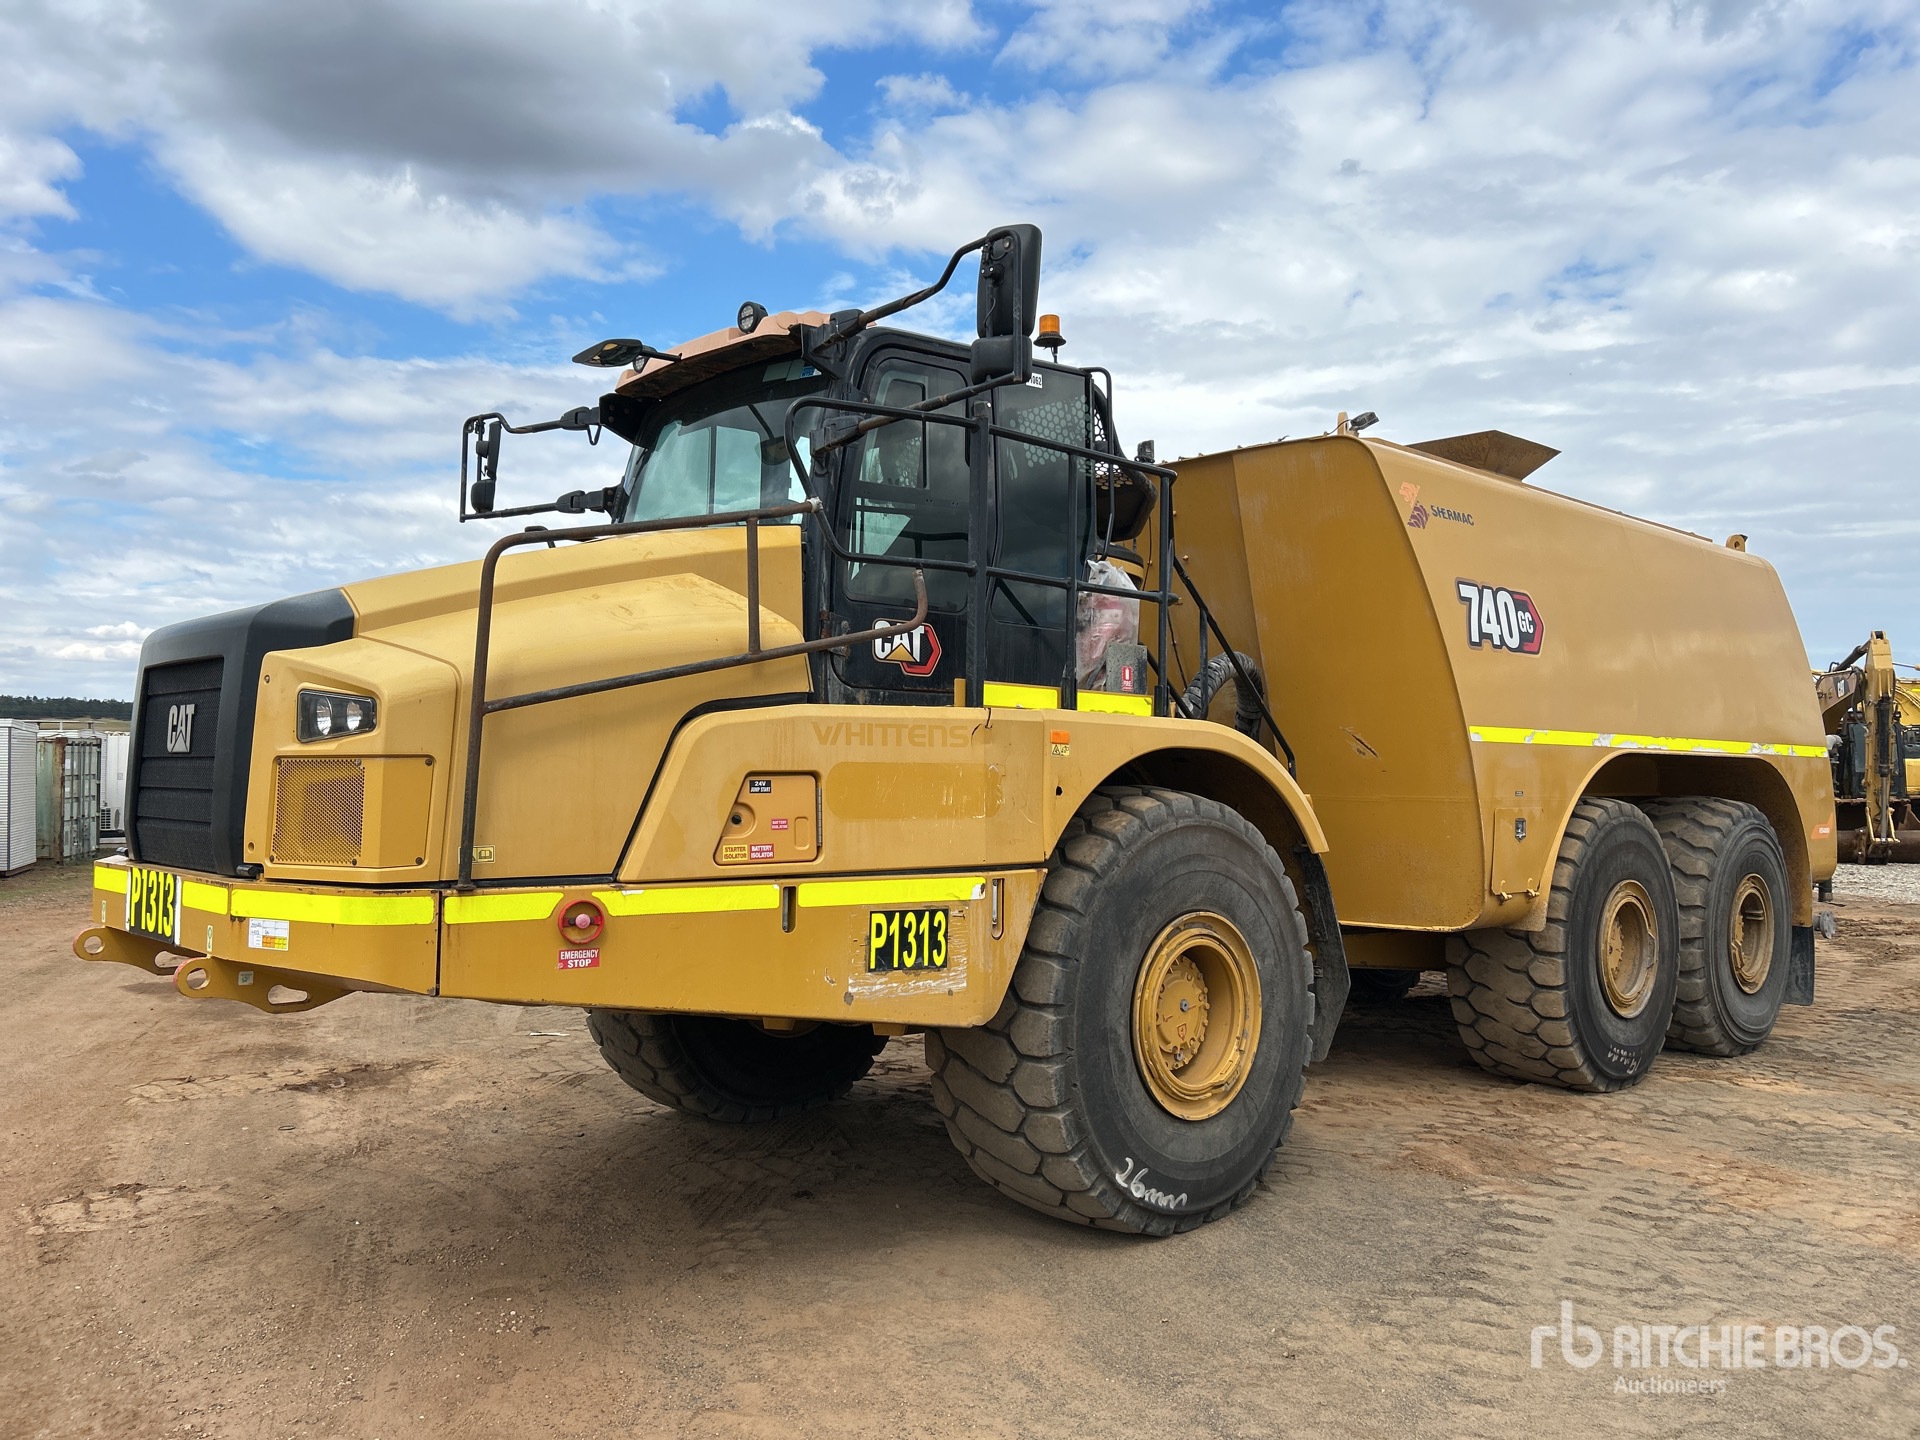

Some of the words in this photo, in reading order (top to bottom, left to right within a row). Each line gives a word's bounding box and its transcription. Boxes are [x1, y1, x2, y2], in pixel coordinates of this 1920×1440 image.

[1430, 504, 1475, 527] SHERMAC
[1458, 583, 1520, 649] 740
[1517, 610, 1534, 634] GC
[874, 620, 925, 662] CAT
[167, 703, 195, 753] CAT
[811, 721, 970, 748] WHITTENS
[130, 867, 175, 937] P1313
[560, 949, 599, 960] EMERGENCY
[870, 911, 947, 969] P1313
[567, 959, 592, 968] STOP
